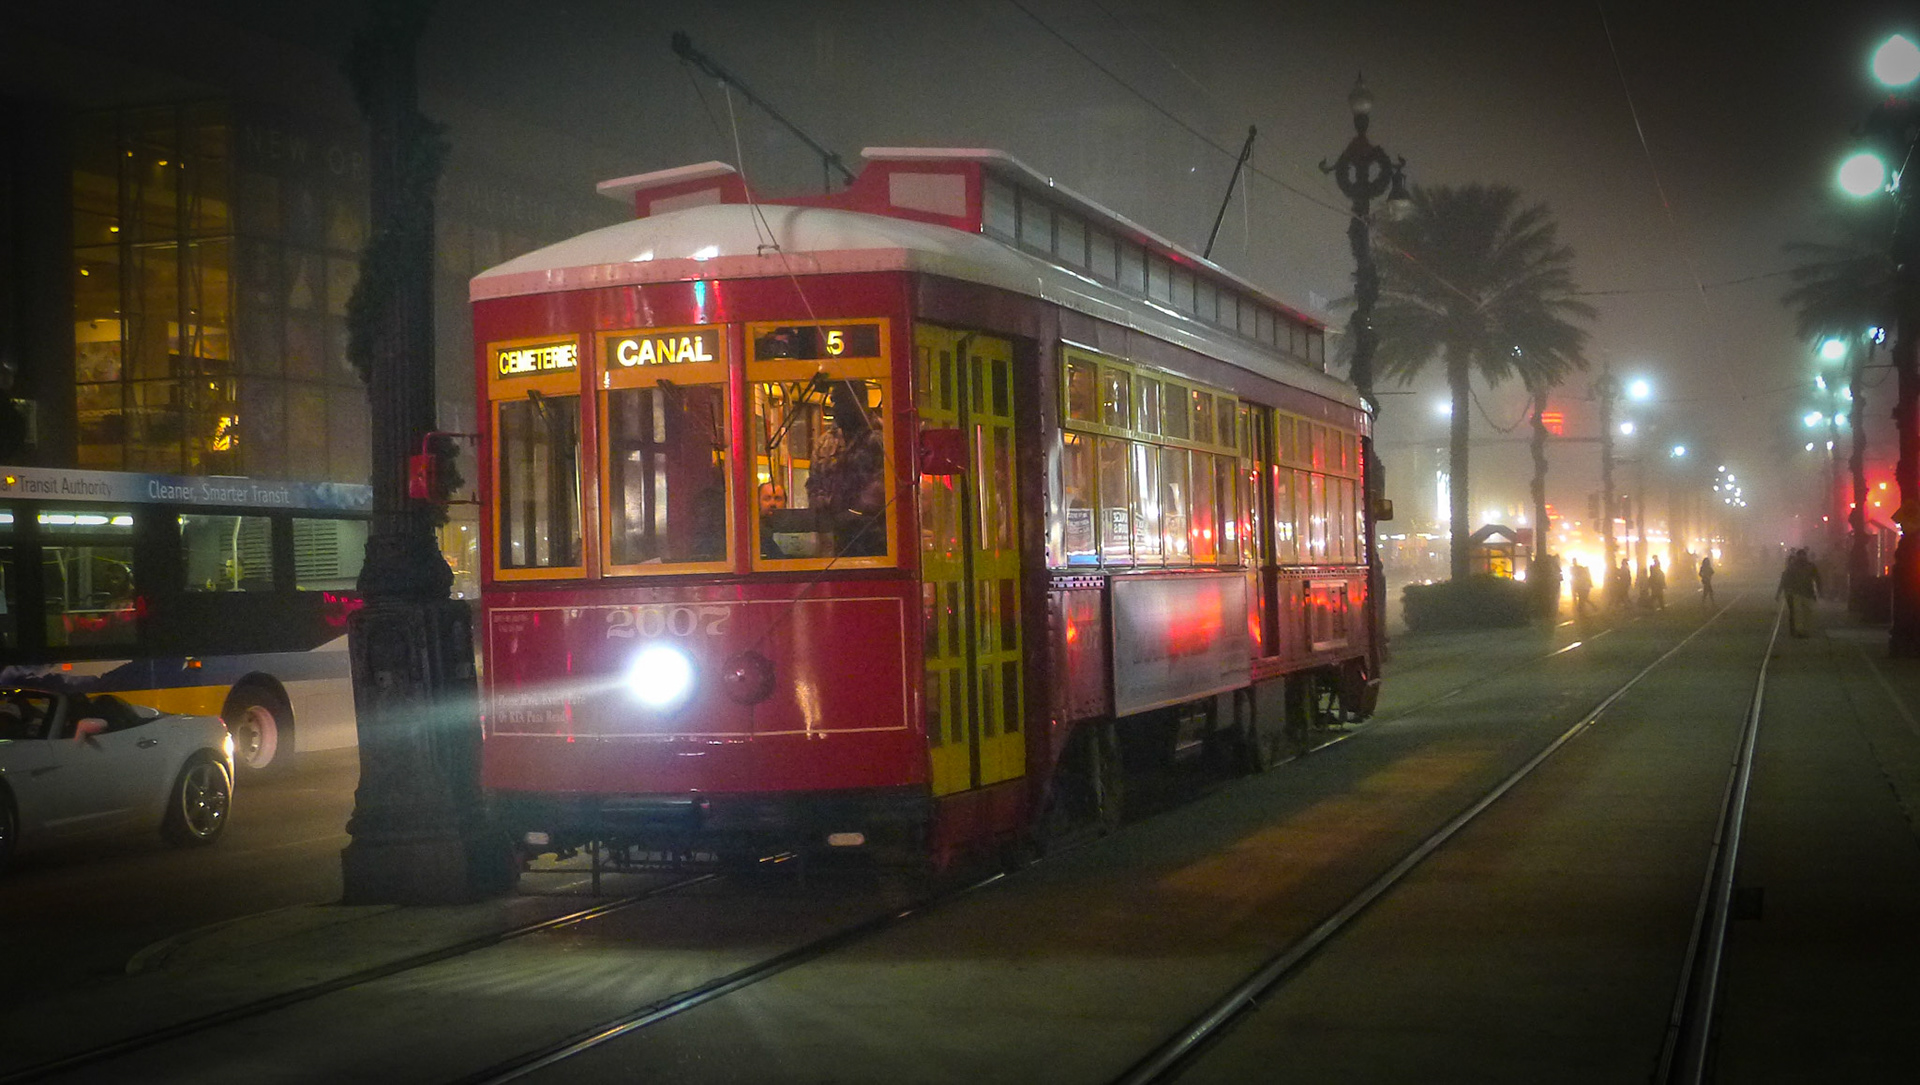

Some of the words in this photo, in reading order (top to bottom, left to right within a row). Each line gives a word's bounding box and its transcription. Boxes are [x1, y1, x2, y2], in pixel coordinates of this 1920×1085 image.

[616, 336, 713, 367] CANAL
[826, 330, 845, 355] 5
[499, 344, 578, 375] CEMETERIES
[18, 475, 59, 495] Transit
[61, 478, 113, 497] Authority
[148, 479, 197, 501] Cleaner,
[201, 482, 249, 502] Smarter
[251, 485, 291, 504] Transit
[606, 605, 731, 639] 2007
